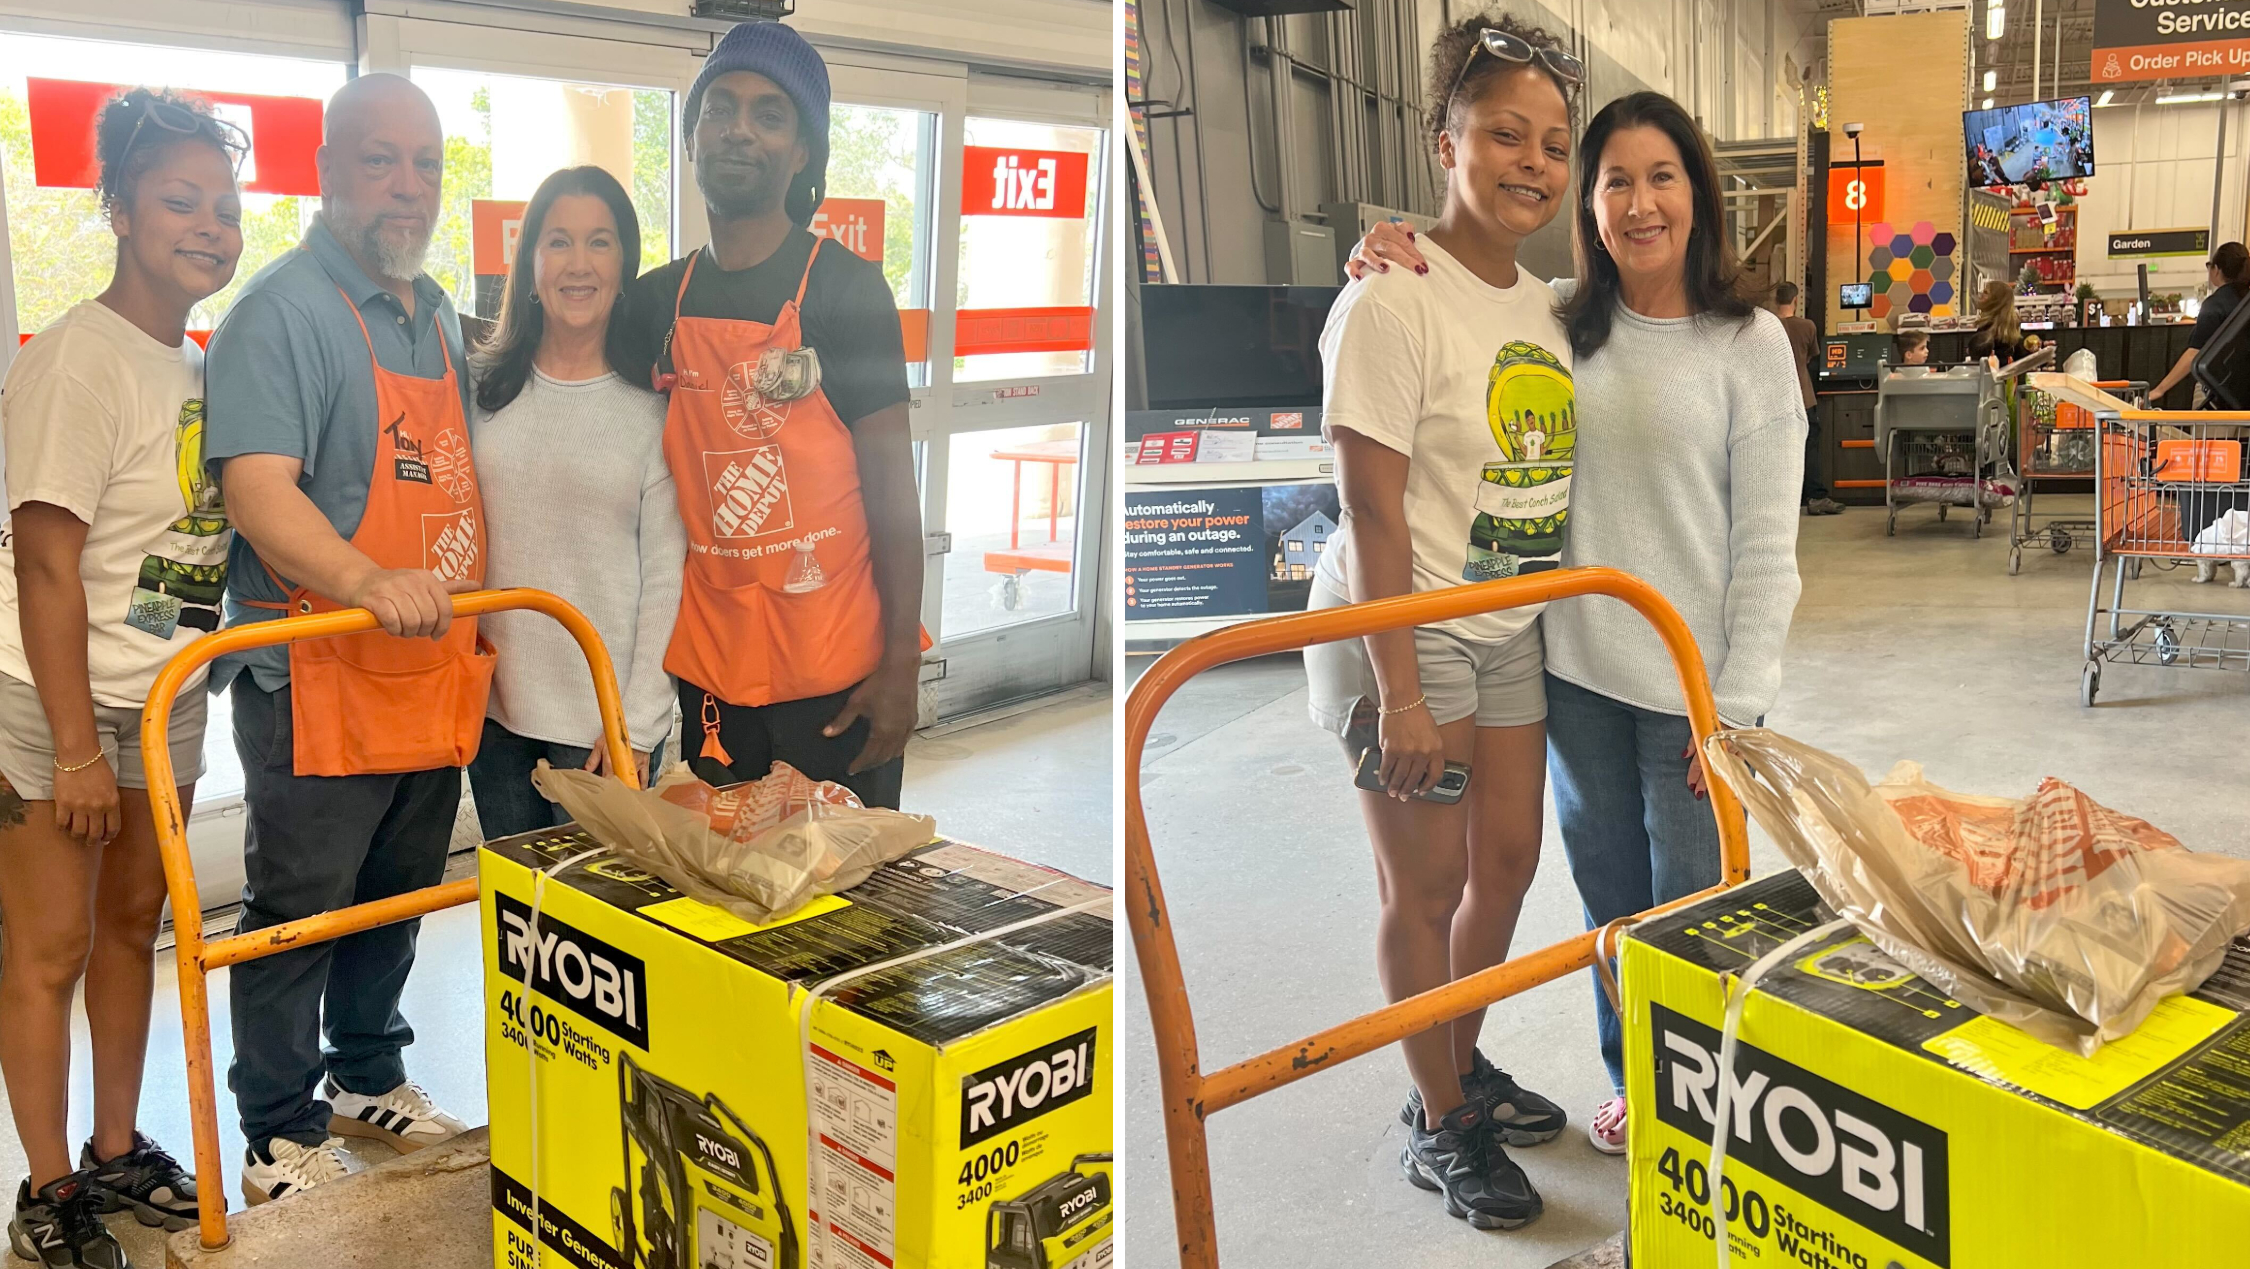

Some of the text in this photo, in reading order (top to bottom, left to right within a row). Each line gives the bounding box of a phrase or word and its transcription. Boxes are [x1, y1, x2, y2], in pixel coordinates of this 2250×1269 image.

[2157, 8, 2250, 34] Service
[2130, 48, 2250, 71] Order Pick Up
[1845, 179, 1867, 210] 8
[2112, 239, 2151, 250] Garden
[1174, 417, 1250, 426] GENERAC
[713, 460, 743, 496] THE
[714, 446, 783, 537] HOME
[741, 475, 787, 536] DEPOT
[1501, 498, 1512, 507] The
[1511, 498, 1528, 509] Best
[1528, 495, 1549, 508] Conch
[1124, 515, 1249, 531] estore your power
[1168, 533, 1186, 542] an
[1187, 528, 1241, 542] outage.
[431, 523, 455, 559] THE
[711, 544, 740, 558] doers
[742, 544, 763, 560] get
[765, 538, 801, 555] more
[1138, 547, 1184, 557] comfortable,
[1184, 546, 1200, 555] safe
[1200, 545, 1214, 554] and
[1214, 544, 1254, 553] connected.
[1467, 555, 1513, 571] PINEAPPLE
[132, 598, 176, 614] PINEAPPLE
[138, 609, 175, 625] EXPRESS
[502, 908, 636, 1028] RYOBI
[562, 1020, 610, 1065] Starting
[562, 1037, 598, 1071] Watts
[875, 1055, 893, 1070] UP
[968, 1042, 1087, 1133] RYOBI
[1664, 1029, 1924, 1233] RYOBI
[695, 1133, 741, 1169] RYOBI
[958, 1140, 1019, 1187] 4000
[957, 1182, 992, 1210] 3400
[1059, 1186, 1097, 1218] RYOBI
[1657, 1146, 1770, 1239] 4000
[1659, 1191, 1716, 1241] 3400
[1773, 1203, 1868, 1269] Starting
[747, 1243, 766, 1260] RYOBI
[1728, 1243, 1747, 1260] atts
